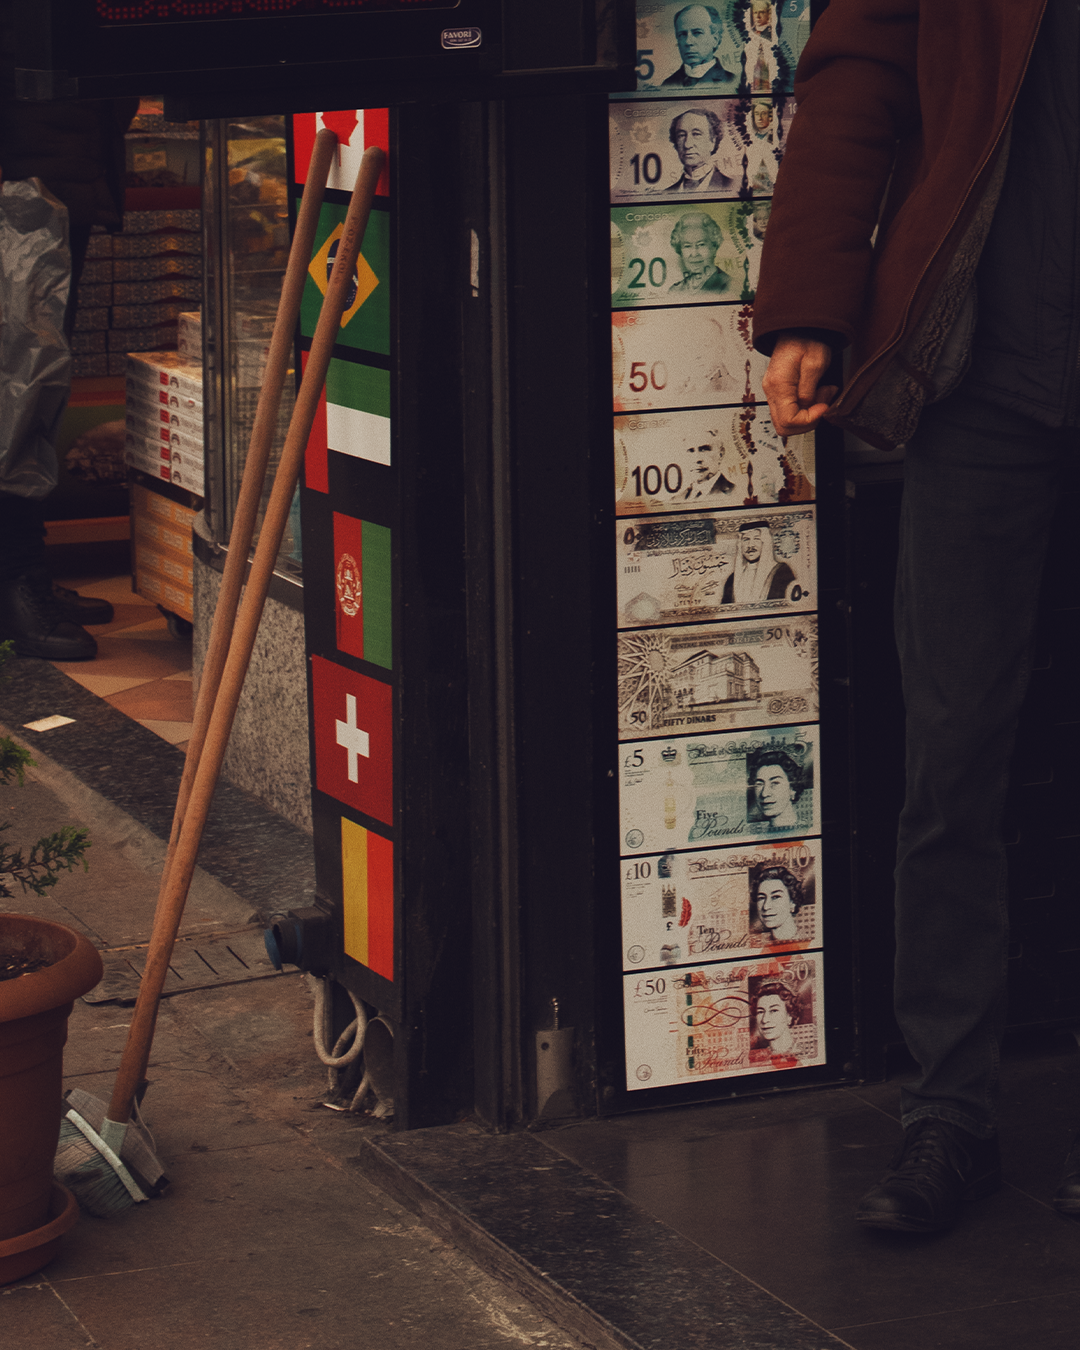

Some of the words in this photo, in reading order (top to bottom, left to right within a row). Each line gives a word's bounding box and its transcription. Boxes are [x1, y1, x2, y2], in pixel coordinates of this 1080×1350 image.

[635, 3, 665, 13] nada
[789, 0, 798, 12] 5
[636, 50, 655, 81] 5
[630, 152, 662, 185] 10
[627, 257, 667, 289] 20
[629, 361, 668, 392] 50
[632, 463, 682, 497] 100
[766, 627, 783, 641] 50
[630, 711, 647, 725] 50
[663, 717, 685, 726] FIFTY
[687, 715, 716, 725] DINARS
[624, 749, 645, 768] £5
[696, 810, 718, 819] Five
[690, 816, 745, 838] Pounds
[785, 845, 809, 868] 10
[625, 862, 651, 881] £10
[696, 925, 715, 935] Ten
[689, 930, 747, 953] Pounds
[634, 978, 666, 998] £50
